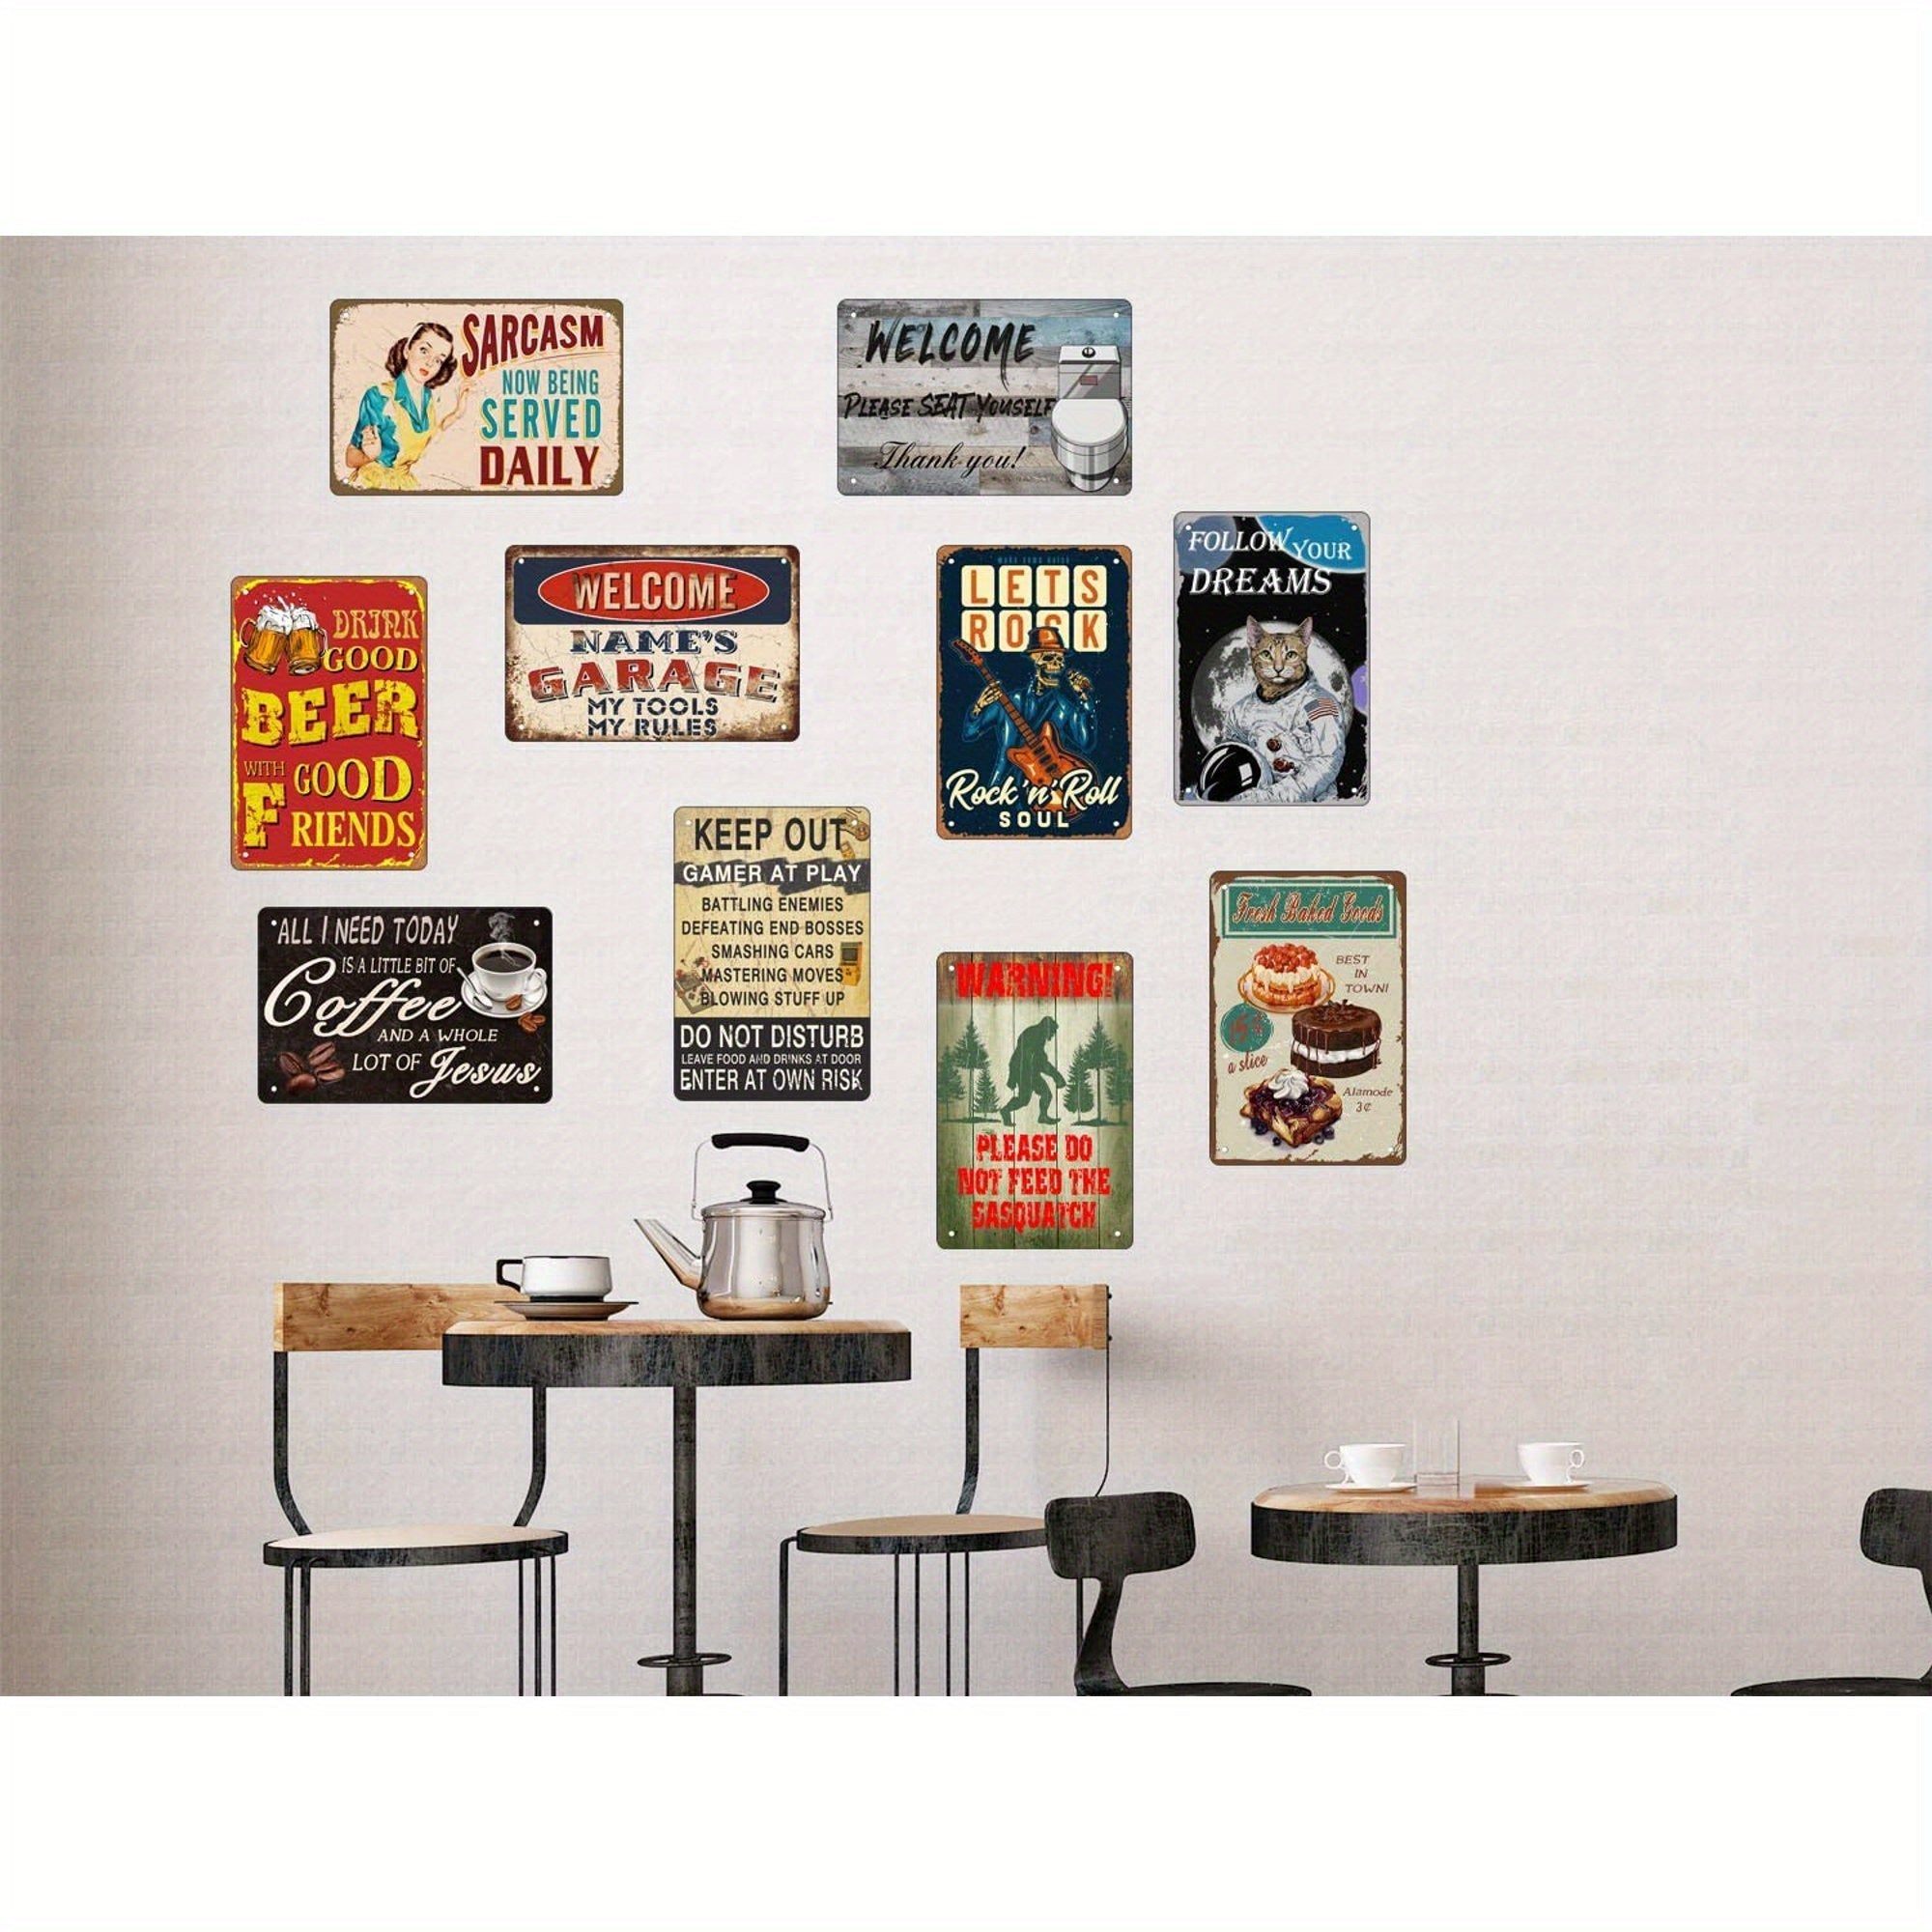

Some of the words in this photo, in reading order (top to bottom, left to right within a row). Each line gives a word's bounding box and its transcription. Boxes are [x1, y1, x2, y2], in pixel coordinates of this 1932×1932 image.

[459, 313, 605, 378] SARCASM
[866, 317, 1036, 392] WELCOME
[502, 369, 540, 394] NOW
[548, 369, 600, 394] BEING
[480, 398, 602, 440] SERVED
[843, 392, 914, 419] PLEASE
[918, 392, 976, 419] SEAT
[480, 445, 600, 486] DAILY
[874, 440, 964, 469] Thank
[960, 445, 1027, 478] you!
[1187, 526, 1293, 552] FOLLOW
[1293, 539, 1352, 560] YOUR
[572, 571, 738, 611] WELCOME
[971, 569, 1099, 604] LETS
[1189, 567, 1333, 596] DREAMS
[332, 610, 419, 639] DRINK
[570, 629, 738, 655] NAME'S
[323, 645, 418, 672] GOOD
[527, 659, 781, 703] GARAGE
[242, 679, 420, 747] BEER
[588, 697, 625, 716] MY
[633, 697, 719, 716] TOOLS
[588, 718, 625, 736] MY
[635, 718, 718, 737] RULES
[243, 761, 287, 777] WITH
[294, 755, 412, 802] GOOD
[999, 811, 1069, 828] SOUL
[695, 818, 773, 851] KEEP
[784, 818, 847, 851] OUT
[683, 865, 762, 883] GAMER
[770, 865, 798, 883] AT
[807, 865, 862, 883] PLAY
[701, 896, 773, 913] BATTLING
[779, 896, 844, 913] ENEMIES
[1233, 891, 1279, 923] Fresh
[1281, 891, 1334, 923] Baked
[1340, 891, 1384, 923] Goods
[277, 917, 313, 945] ALL
[322, 916, 328, 945] I
[335, 916, 384, 945] NEED
[393, 915, 459, 945] TODAY
[681, 920, 763, 936] DEFEATING
[769, 920, 800, 936] END
[805, 920, 864, 936] BOSSES
[342, 956, 355, 974] IS
[356, 958, 367, 974] A
[370, 957, 412, 974] LITTLE
[416, 957, 436, 974] BIT
[440, 957, 457, 974] OF
[711, 944, 789, 960] SMASHING
[794, 944, 834, 960] CARS
[1336, 954, 1370, 965] BEST
[701, 967, 787, 983] MASTERING
[792, 967, 843, 983] MOVES
[955, 961, 1114, 999] WARNING!
[1354, 968, 1369, 979] IN
[264, 956, 462, 1037] Coffee
[700, 991, 769, 1007] BLOWING
[774, 991, 820, 1007] STUFF
[826, 991, 845, 1007] UP
[377, 1029, 413, 1042] AND
[418, 1029, 430, 1042] A
[438, 1029, 498, 1042] WHOLE
[680, 1024, 712, 1049] DO
[719, 1024, 764, 1049] NOT
[771, 1024, 865, 1049] DISTURB
[353, 1053, 391, 1071] LOT
[395, 1053, 422, 1071] OF
[410, 1045, 542, 1098] Jesus
[681, 1053, 713, 1065] LEAVE
[717, 1053, 746, 1065] FOOD
[749, 1053, 771, 1065] AND
[774, 1053, 812, 1065] DRINKS
[814, 1053, 829, 1065] AT
[831, 1053, 862, 1065] DOOR
[1228, 1062, 1236, 1073] a
[1238, 1050, 1268, 1072] slice
[680, 1068, 738, 1091] ENTER
[744, 1068, 767, 1091] AT
[773, 1068, 815, 1091] OWN
[822, 1068, 864, 1091] RISK
[1343, 1087, 1393, 1097] Alamode
[976, 1133, 1058, 1162] PLEASE
[1065, 1133, 1094, 1162] DO
[956, 1166, 1003, 1197] NOT
[1008, 1166, 1063, 1197] FEED
[1068, 1166, 1111, 1197] THE
[971, 1201, 1096, 1234] SASQUATCH
